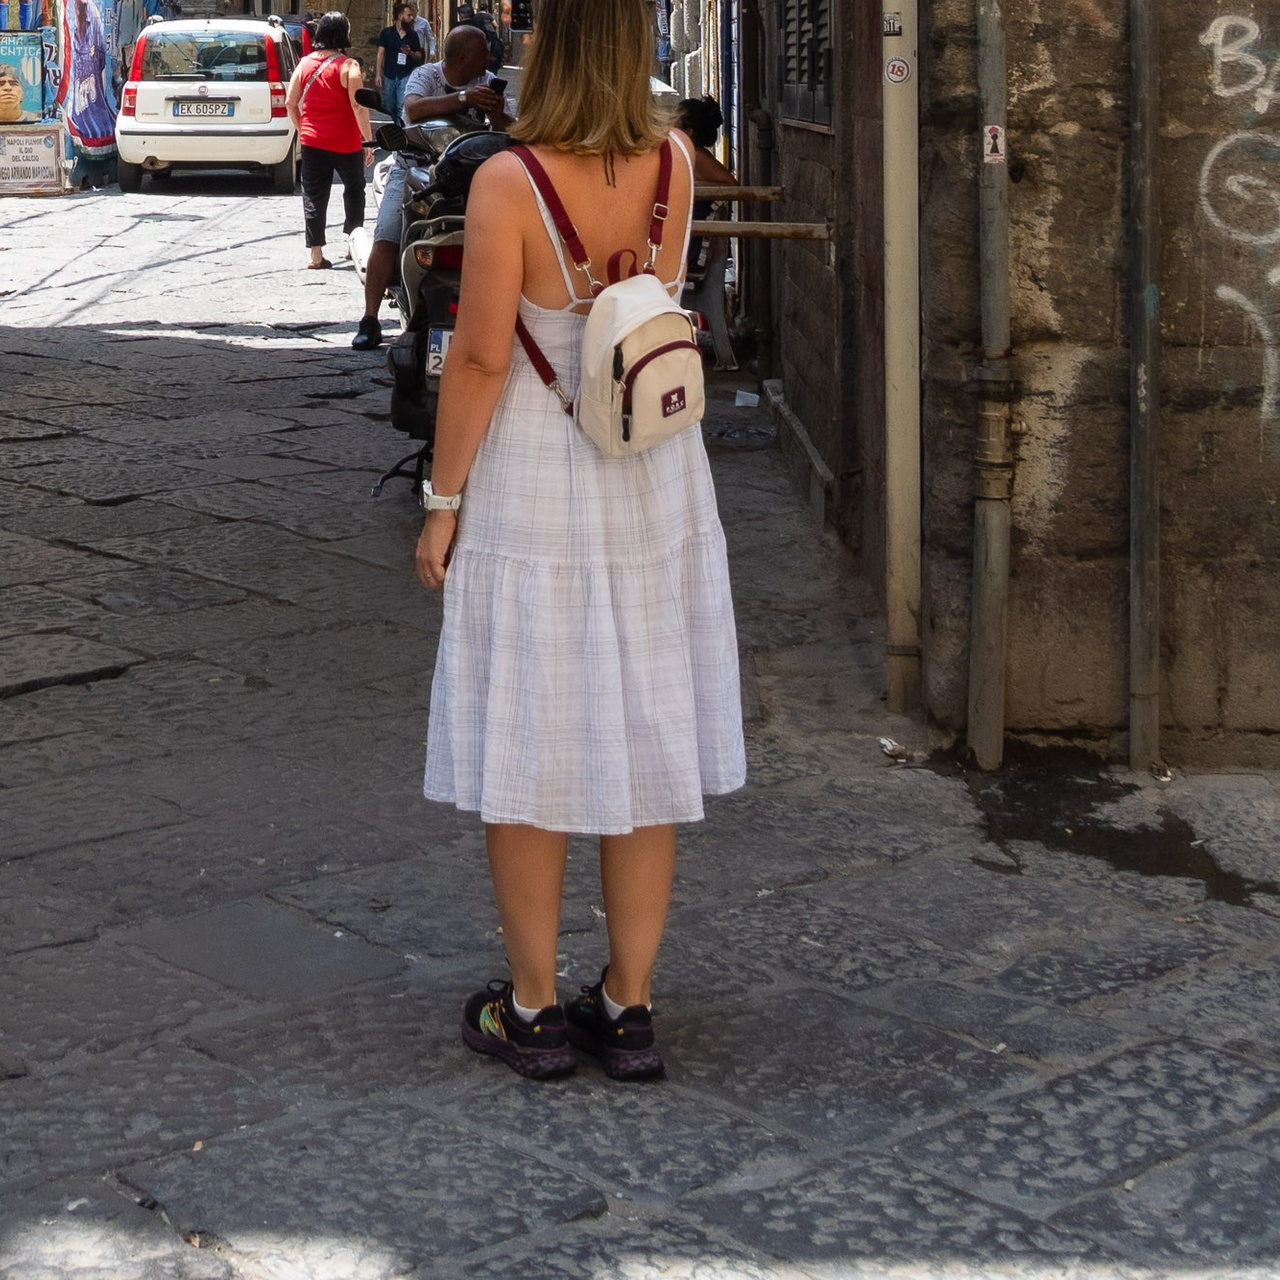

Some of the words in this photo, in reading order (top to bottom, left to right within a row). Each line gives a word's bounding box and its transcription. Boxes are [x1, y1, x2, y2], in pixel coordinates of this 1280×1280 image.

[889, 63, 905, 77] 18
[180, 103, 193, 115] EK
[195, 102, 227, 115] 605PZ
